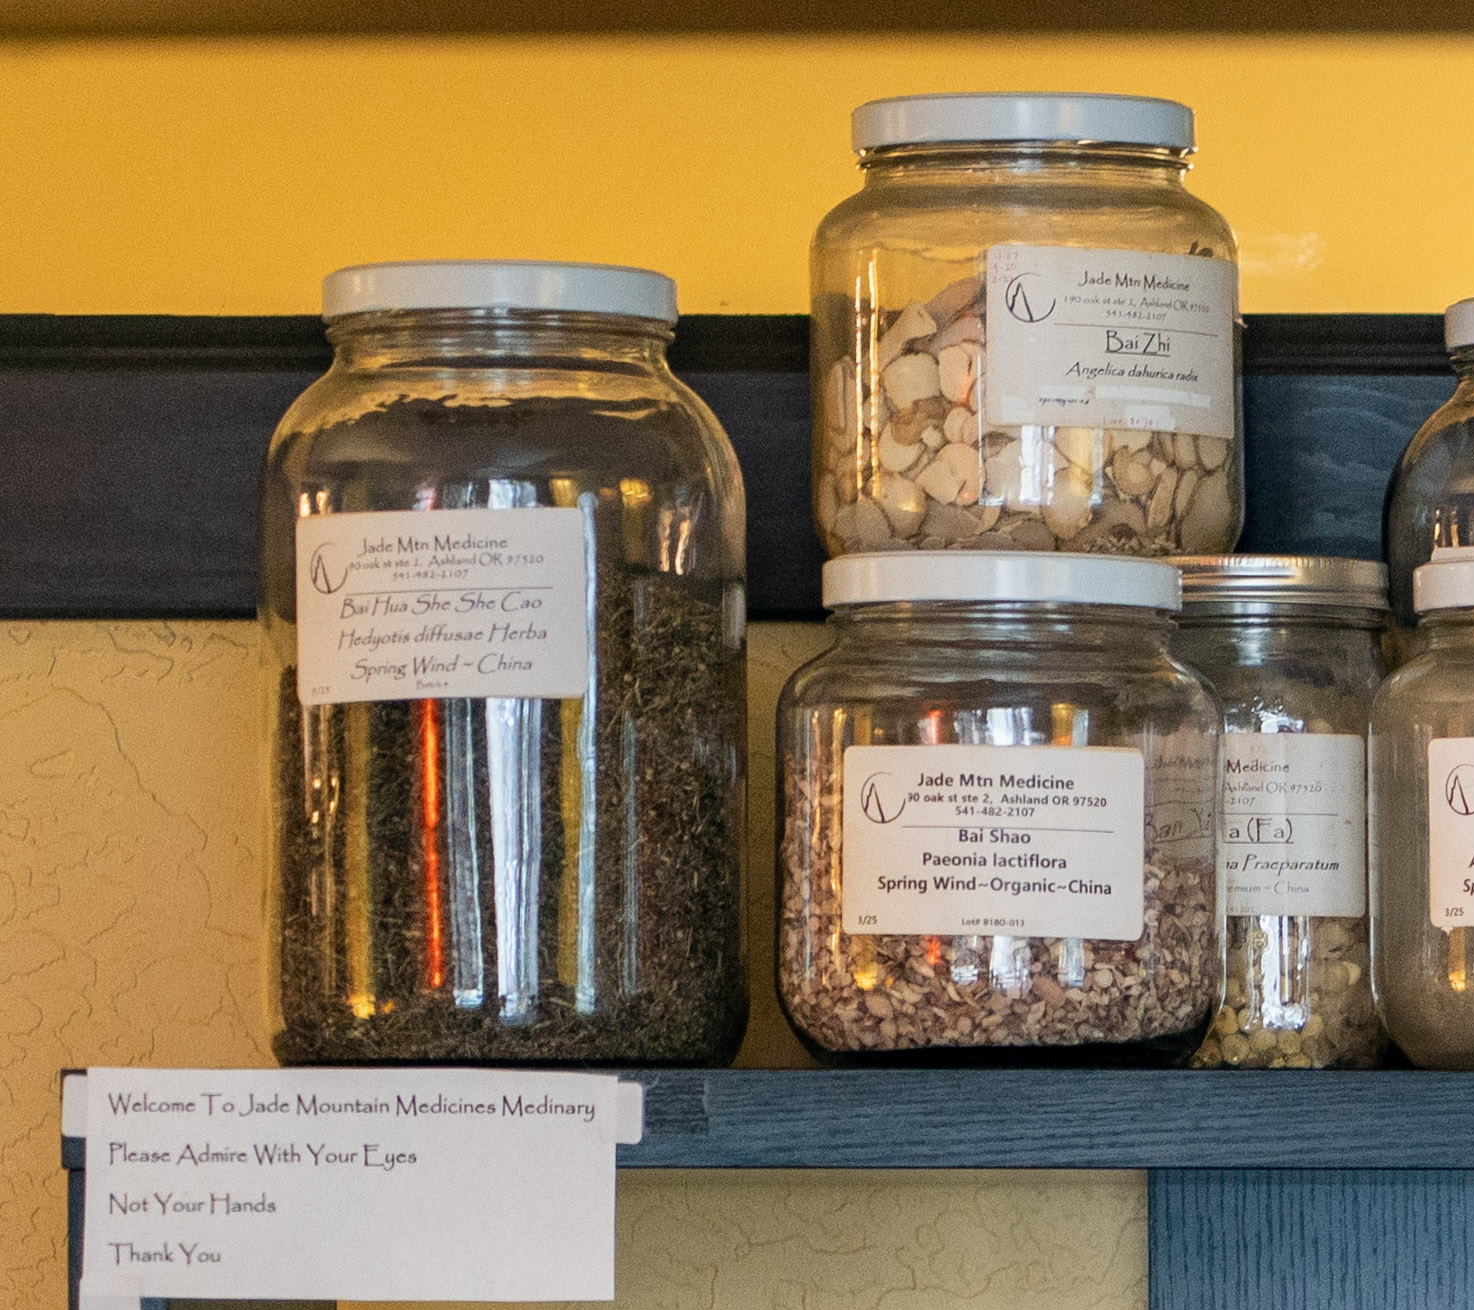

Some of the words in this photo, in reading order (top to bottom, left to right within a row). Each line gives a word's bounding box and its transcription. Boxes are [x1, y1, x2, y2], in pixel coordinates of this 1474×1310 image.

[1106, 330, 1138, 353] Bai
[1142, 333, 1170, 354] Zhi
[340, 596, 371, 619] Bai
[371, 594, 409, 616] Hua
[410, 593, 450, 614] She
[455, 592, 495, 612] She
[501, 592, 542, 612] Cao
[918, 773, 953, 786] Jade
[960, 774, 993, 787] Mtn
[1000, 775, 1074, 790] Medicine
[959, 828, 983, 842] Bai
[990, 828, 1031, 844] Shao
[923, 852, 987, 866] Paeonia
[993, 853, 1066, 869] lactiflora
[858, 915, 877, 925] 3/25
[108, 1093, 195, 1115] Welcome
[201, 1093, 235, 1116] To
[239, 1093, 289, 1117] Jade
[297, 1094, 389, 1116] Mountain
[396, 1094, 496, 1116] Medicines
[502, 1095, 595, 1122] Medinary
[109, 1142, 170, 1165] Please
[177, 1144, 247, 1166] Admire
[253, 1144, 301, 1165] With
[306, 1144, 357, 1166] Your
[363, 1144, 417, 1171] Eyes
[109, 1193, 148, 1214] Not
[154, 1193, 204, 1215] Your
[210, 1193, 276, 1215] Hands
[108, 1243, 173, 1265] Thank
[179, 1243, 221, 1265] You
